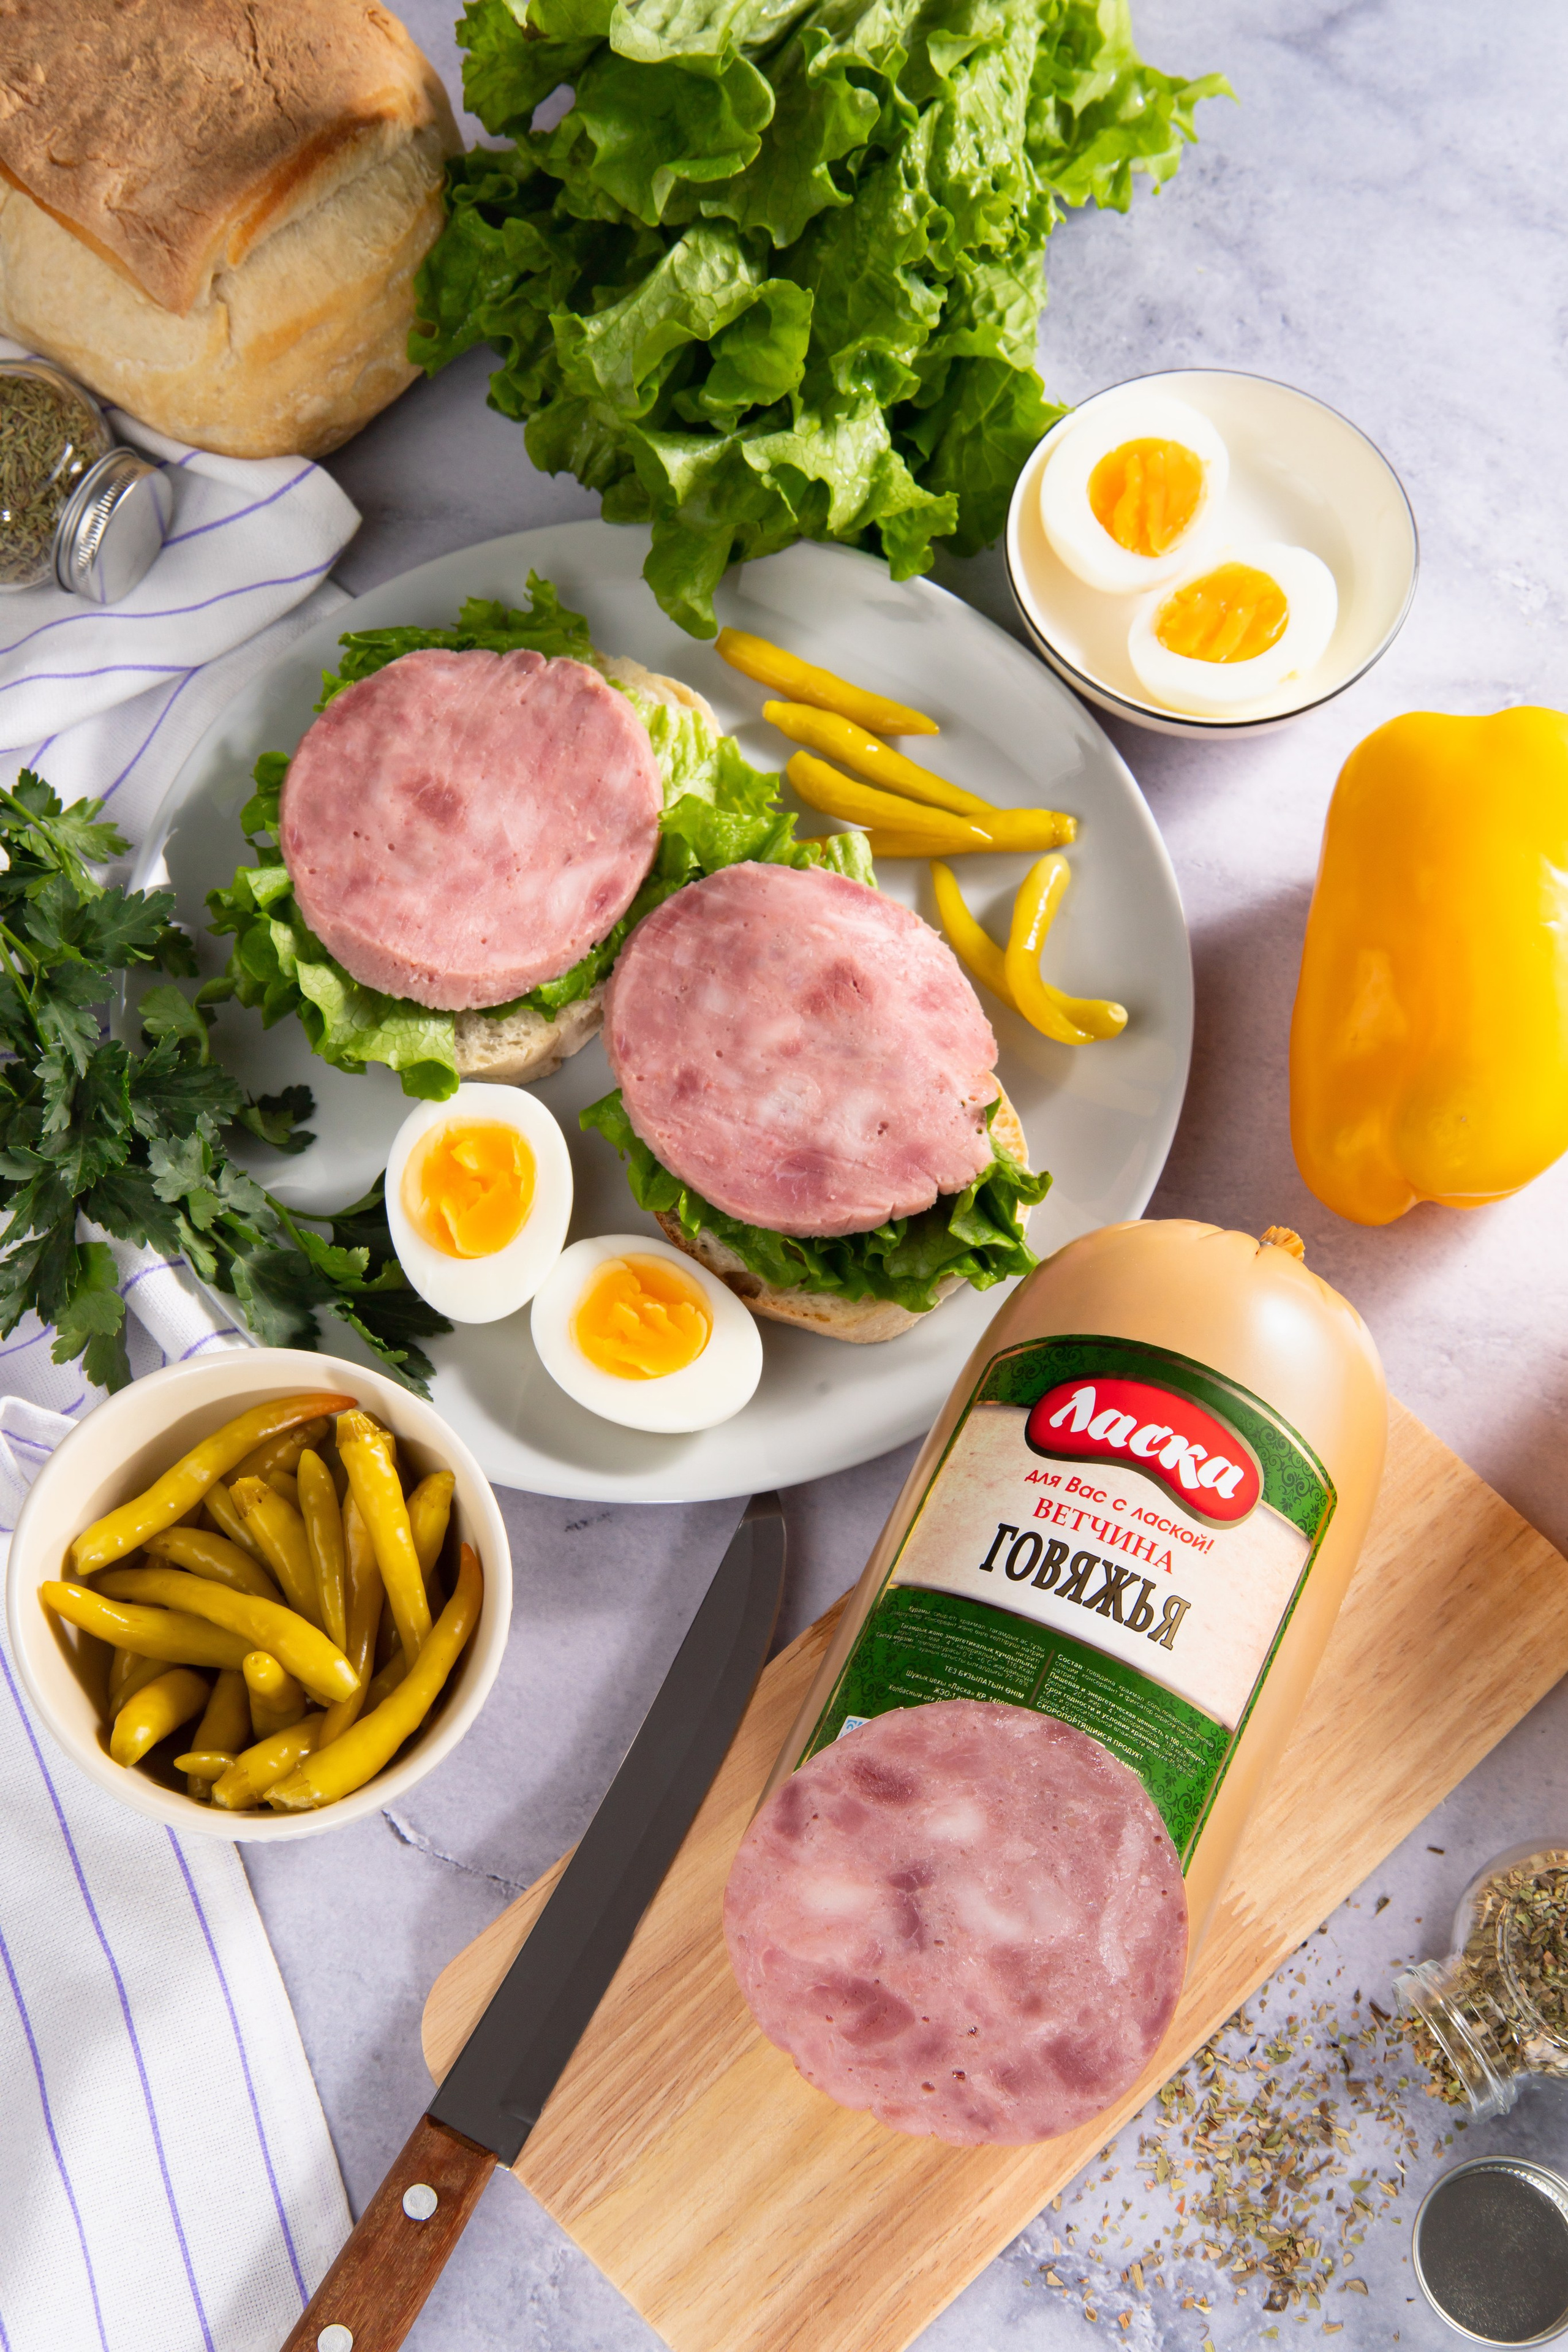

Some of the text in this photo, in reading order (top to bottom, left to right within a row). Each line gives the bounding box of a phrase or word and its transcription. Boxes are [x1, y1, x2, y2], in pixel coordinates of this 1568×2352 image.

[1049, 1386, 1245, 1499] Ласка
[1025, 1469, 1215, 1556] для Вас с лаской!
[1032, 1497, 1173, 1575] ВЕТЧИНА
[979, 1523, 1192, 1651] ГОВЯЖЬЯ
[944, 1665, 957, 1675] ТЕЗ
[1058, 1654, 1085, 1670] Состав:
[1073, 1689, 1082, 1698] 20
[923, 1695, 935, 1704] цех
[1037, 1698, 1144, 1761] СКОРОПОРТЯЩИЙСЯ ПРОДУКТ.
[1044, 1684, 1062, 1696] Срок
[1063, 1694, 1095, 1712] годности
[1101, 1713, 1130, 1731] условия
[1131, 1728, 1161, 1749] хранения:
[1049, 1672, 1080, 1691] Пищевая
[1087, 1691, 1136, 1719] энергетическая
[1137, 1717, 1164, 1736] ценность
[1170, 1736, 1180, 1746] 100
